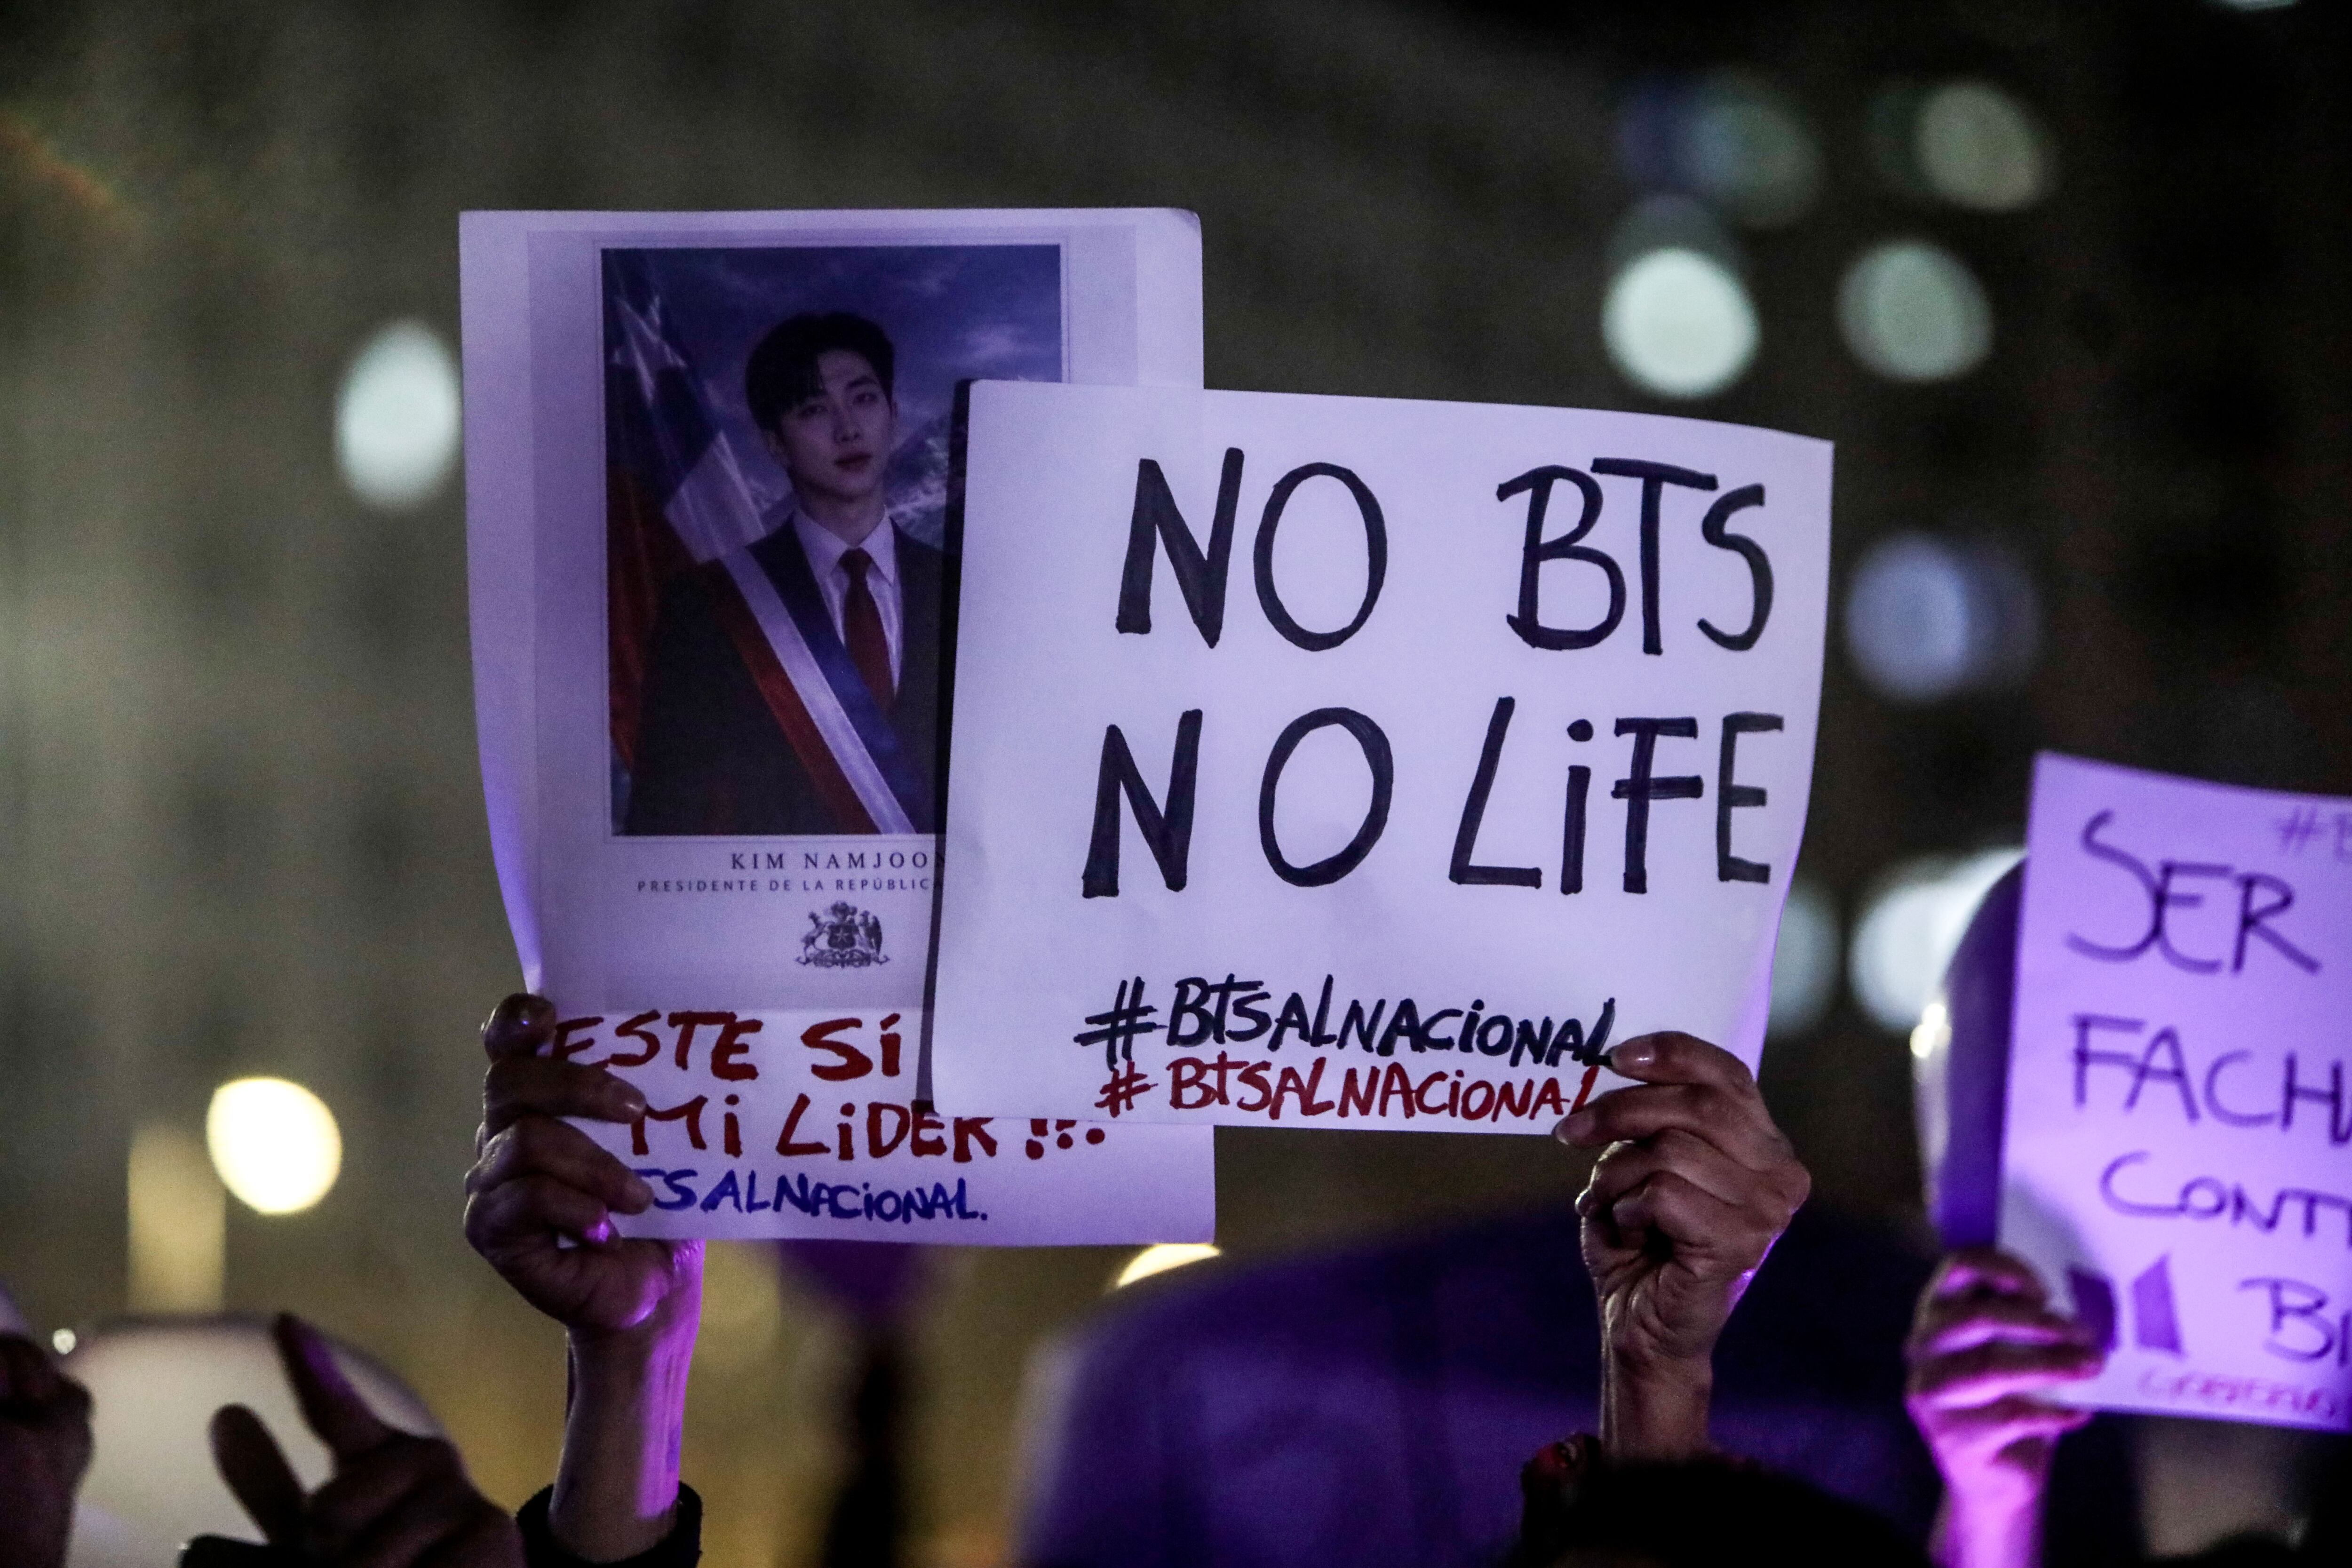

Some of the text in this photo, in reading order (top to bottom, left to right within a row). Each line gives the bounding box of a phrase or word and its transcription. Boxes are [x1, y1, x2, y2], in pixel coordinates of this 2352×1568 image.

[1115, 447, 1774, 655] NO BTS
[1081, 707, 1394, 898] NO
[637, 877, 943, 893] PRESIDENTE DE LA REPÚBLIC
[731, 853, 784, 870] KIM
[2064, 808, 2322, 976] SER
[552, 1010, 763, 1081] ESTE
[2069, 1012, 2352, 1147] FACH
[2099, 1150, 2352, 1250] CONT
